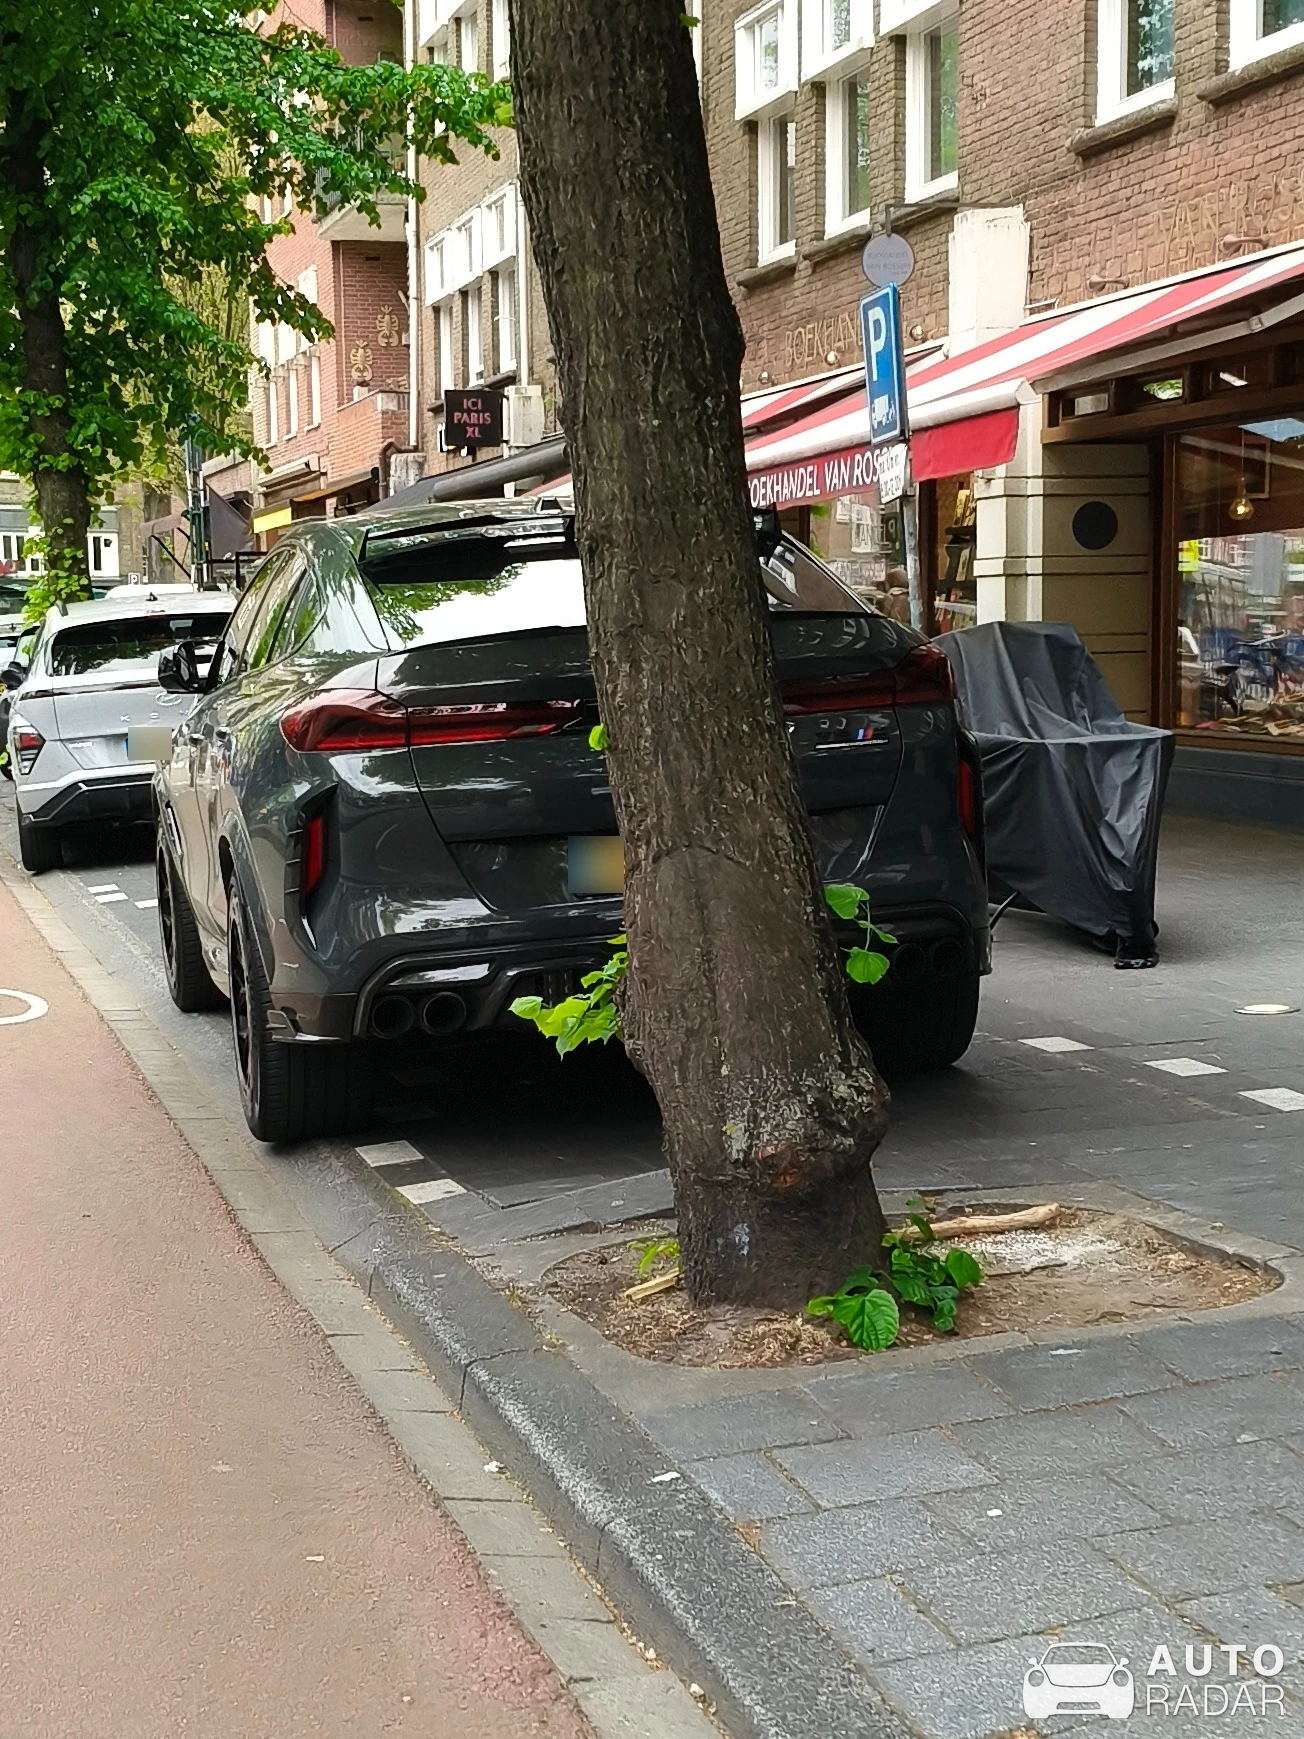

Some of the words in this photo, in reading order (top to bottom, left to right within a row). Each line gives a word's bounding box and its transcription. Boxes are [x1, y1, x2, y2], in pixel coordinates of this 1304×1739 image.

[1159, 184, 1220, 253] VAN
[785, 309, 862, 367] BOEKHAN
[867, 306, 887, 382] P
[453, 412, 492, 424] PARIS
[463, 398, 482, 410] ICI
[466, 426, 482, 438] XL
[748, 464, 821, 509] OEKHANDEL
[824, 456, 850, 490] VAN
[852, 447, 890, 487] ROS
[119, 709, 190, 723] KON
